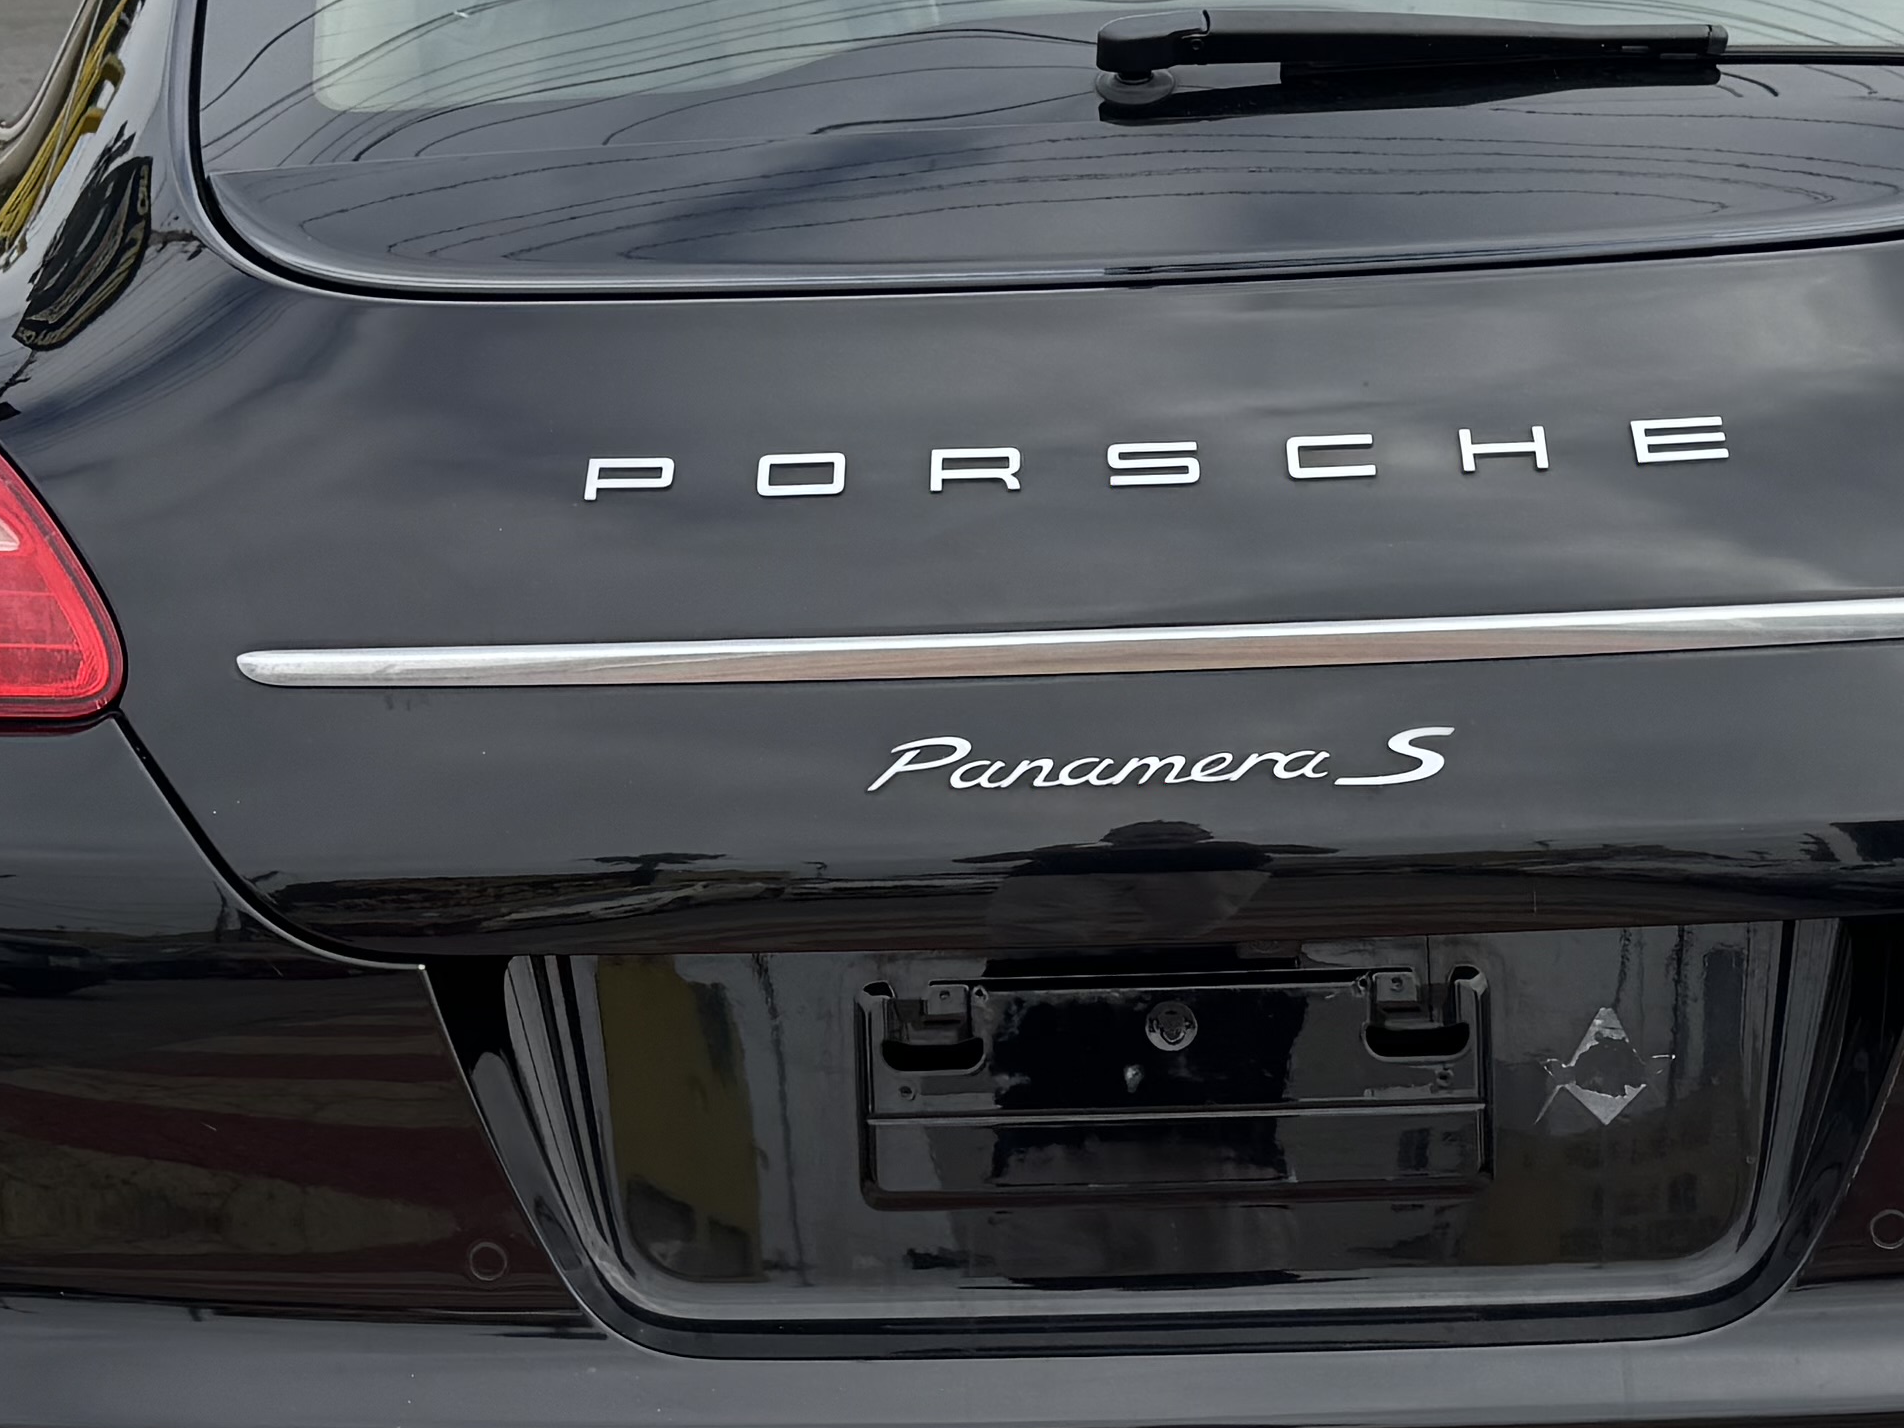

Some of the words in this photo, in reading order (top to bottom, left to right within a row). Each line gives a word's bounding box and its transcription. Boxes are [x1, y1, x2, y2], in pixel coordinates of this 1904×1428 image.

[583, 415, 1731, 501] PORSCHE
[867, 735, 1331, 792] Panamera
[1333, 727, 1456, 787] S
